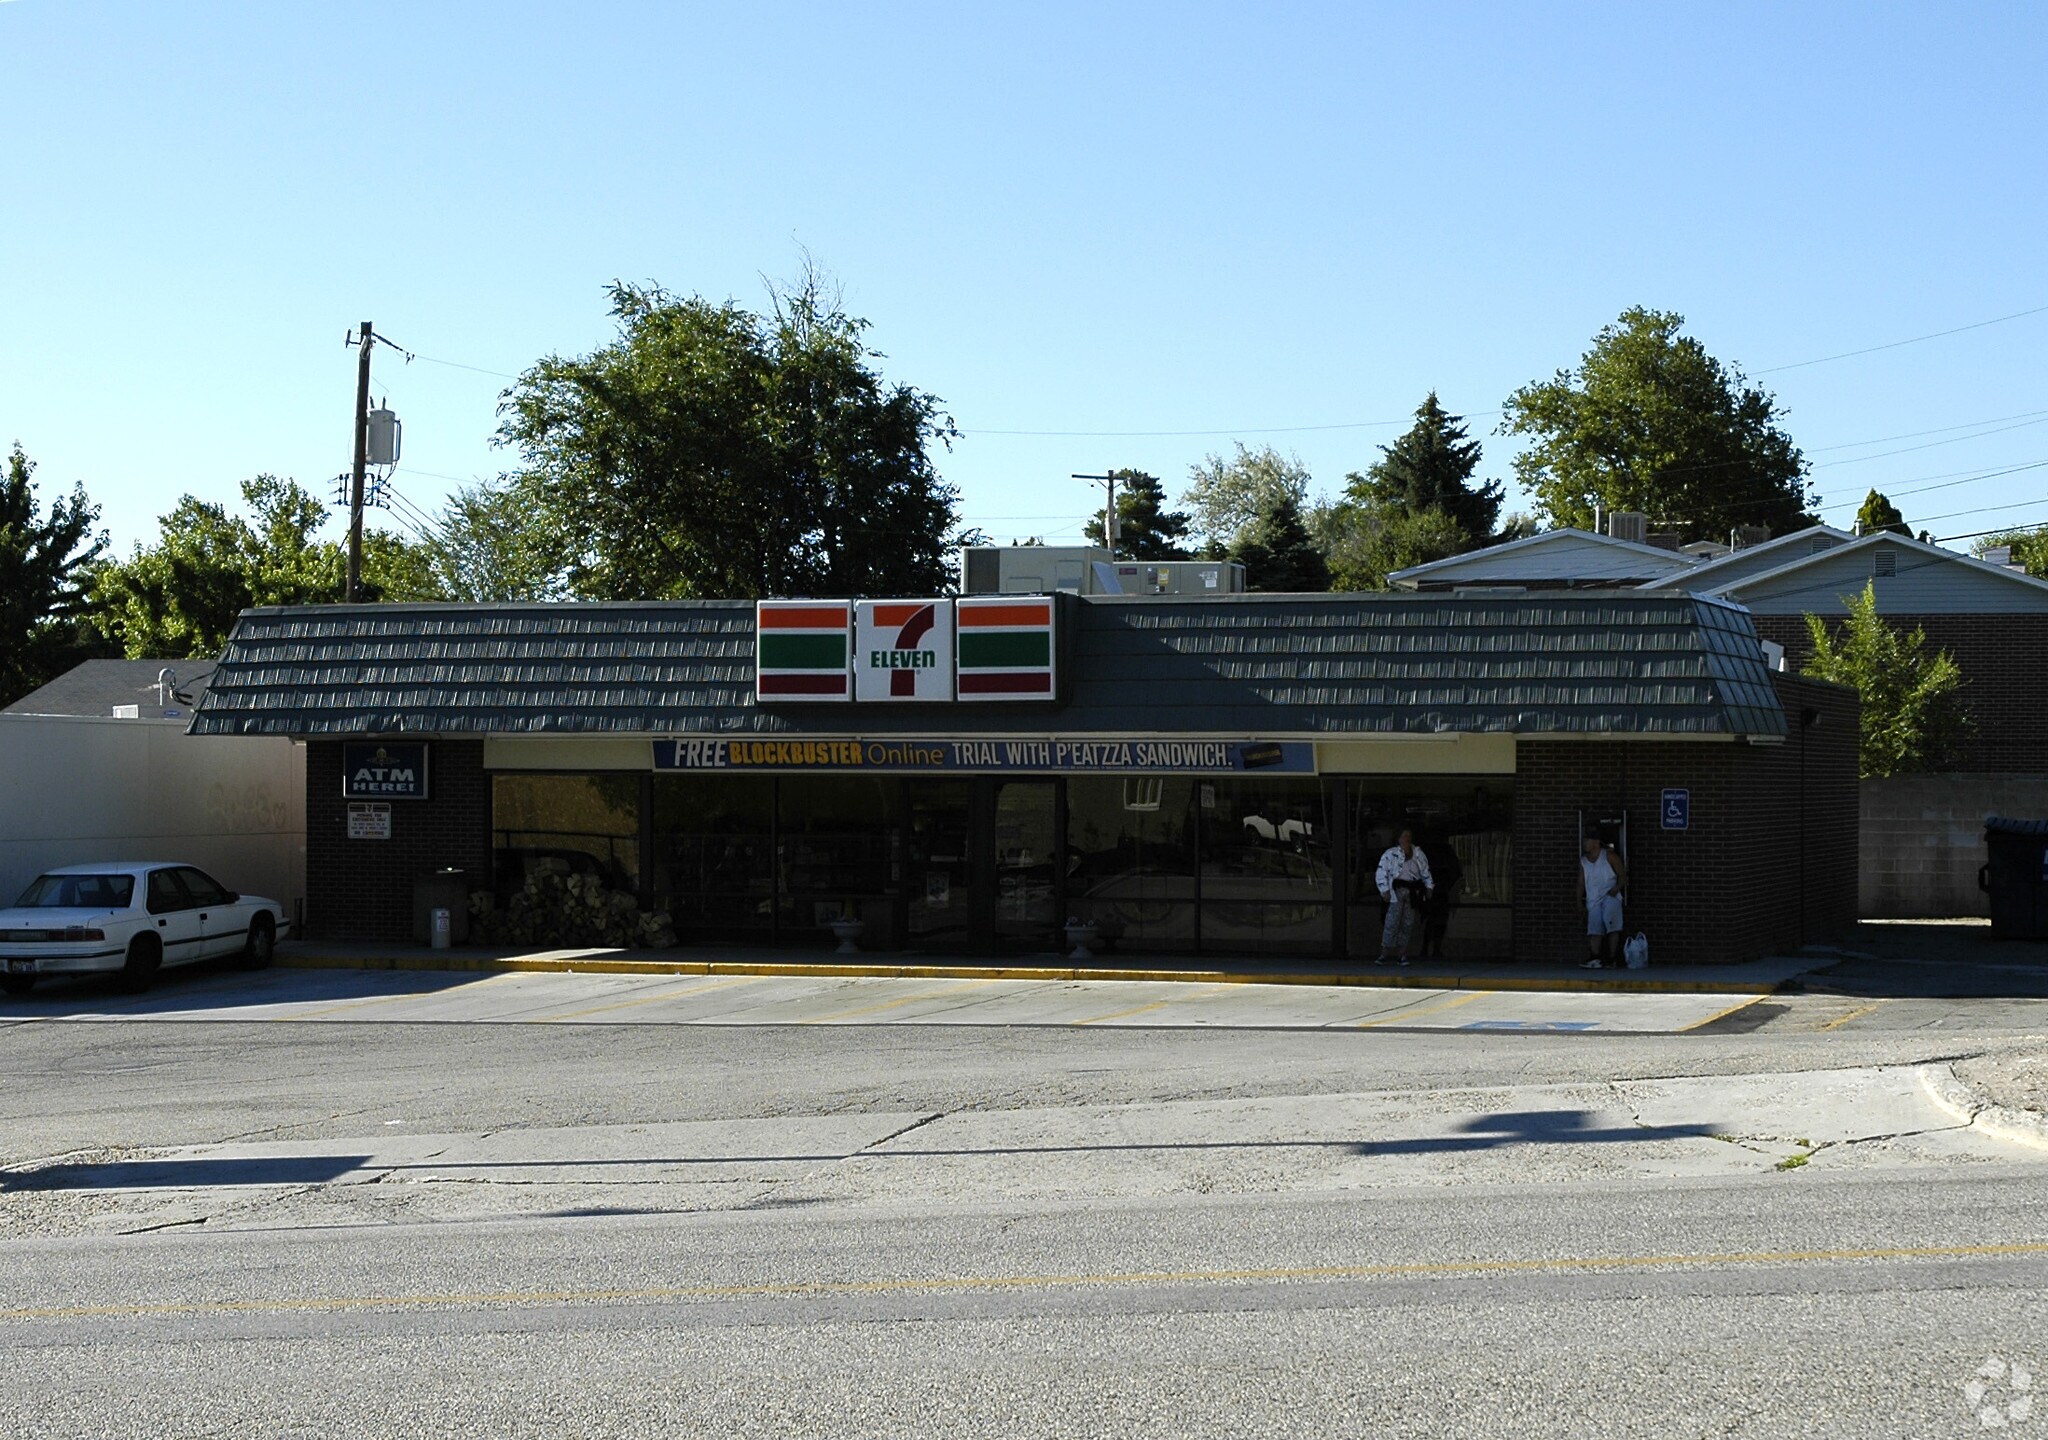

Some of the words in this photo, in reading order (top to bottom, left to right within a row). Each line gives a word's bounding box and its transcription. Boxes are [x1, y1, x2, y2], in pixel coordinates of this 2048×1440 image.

[874, 604, 934, 695] 7
[674, 739, 726, 767] FREE
[729, 742, 863, 765] BLOCKBUSTER
[867, 743, 944, 765] Online
[952, 742, 1001, 765] TRIAL
[1006, 743, 1051, 765] WITH
[1057, 743, 1132, 766] P'EATZZA
[1137, 743, 1233, 766] SANDWICH.
[354, 769, 414, 781] ATM
[353, 783, 414, 792] HERE!
